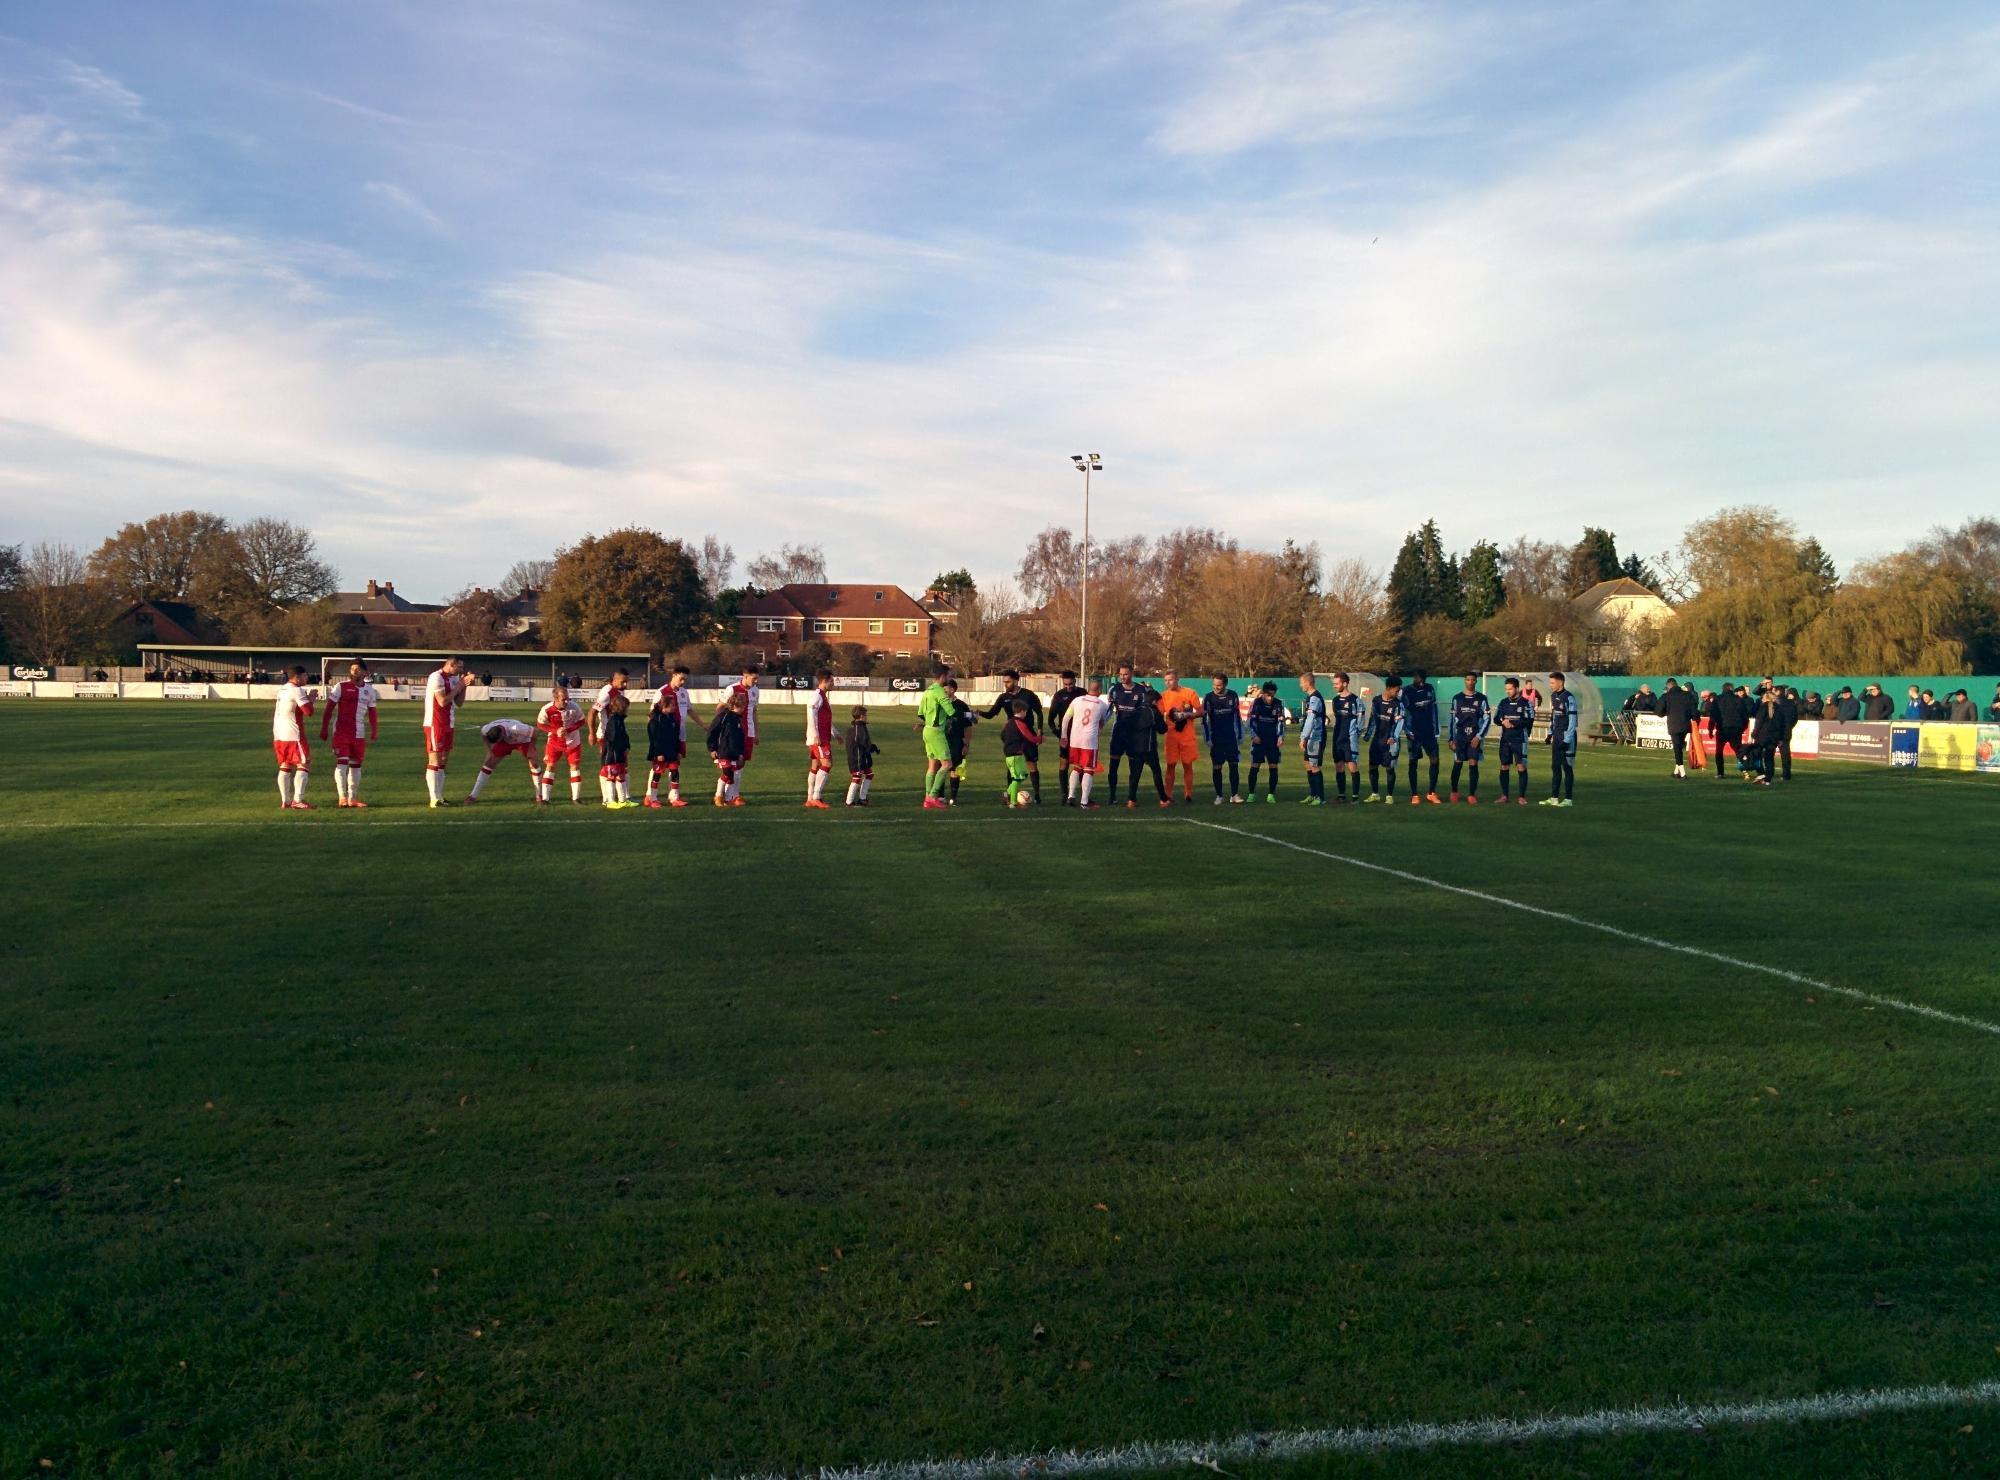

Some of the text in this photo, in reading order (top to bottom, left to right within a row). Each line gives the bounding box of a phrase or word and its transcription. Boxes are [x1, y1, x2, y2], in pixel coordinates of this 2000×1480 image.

[14, 667, 48, 679] Carlsberg
[893, 679, 920, 690] Carlsberg
[1082, 709, 1092, 725] 8
[1641, 739, 1658, 748] 01202
[1891, 750, 1918, 760] sibbett
[1891, 758, 1918, 768] gregory
